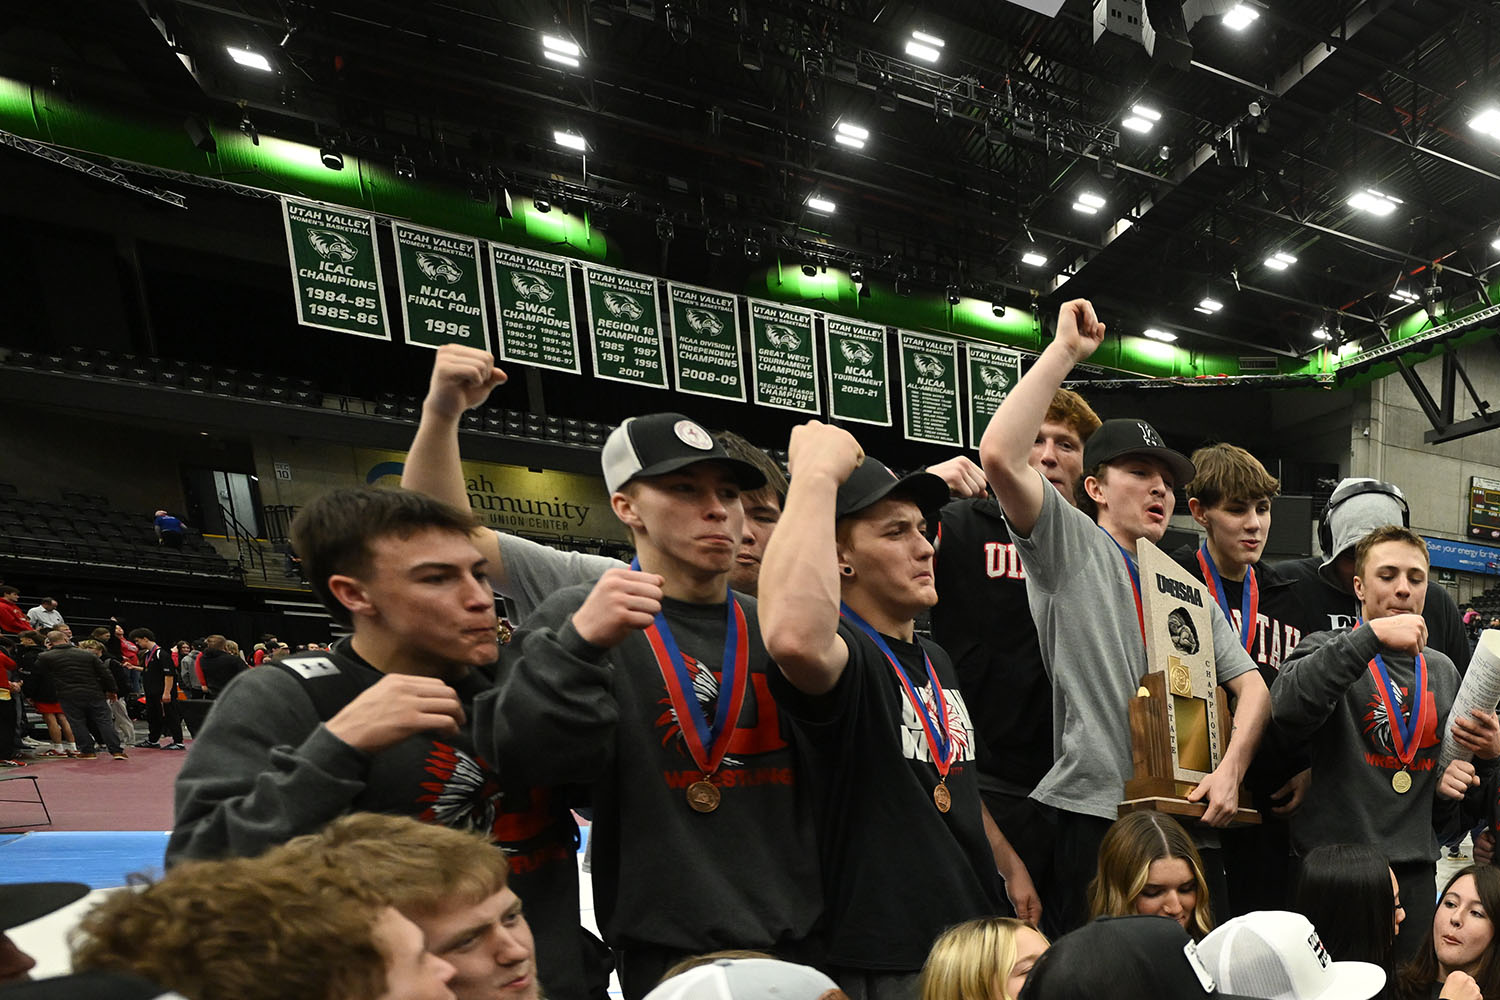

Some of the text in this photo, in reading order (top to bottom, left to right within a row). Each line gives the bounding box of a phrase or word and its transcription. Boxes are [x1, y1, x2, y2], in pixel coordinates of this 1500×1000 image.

[289, 206, 368, 229] UTAH VALLEY
[290, 214, 370, 236] WOMEN'S BASKETBALL
[399, 230, 473, 252] UTAH VALLEY
[400, 238, 474, 259] WOMEN'S BASKETBALL
[319, 261, 354, 276] ICAC
[496, 251, 564, 272] UTAH VALLEY
[496, 259, 565, 278] WOMEN'S BASKETBALL
[300, 268, 376, 291] CHAMPIONS
[590, 272, 652, 290] UTAH VALLEY
[306, 287, 376, 309] 1984-85
[420, 285, 466, 302] NJCAA
[618, 286, 652, 296] BASKETBALL
[673, 290, 732, 306] UTAH VALLEY
[408, 294, 480, 316] FINAL FOUR
[516, 301, 556, 316] SWAC
[700, 302, 733, 312] BASKETBALL
[309, 304, 378, 325] 1985-86
[503, 309, 570, 329] CHAMPIONS
[754, 306, 810, 323] UTAH VALLEY
[425, 319, 470, 338] 1996
[598, 319, 654, 335] REGION 18
[830, 322, 881, 337] UTAH VALLEY
[596, 328, 658, 345] CHAMPIONS
[680, 336, 697, 344] NCAA
[700, 339, 732, 350] DIVISION
[903, 337, 953, 351] UTAH VALLEY
[600, 341, 657, 357] 1985 1987
[679, 344, 736, 358] INDEPENDENT
[759, 348, 810, 363] GREAT WEST
[971, 350, 1017, 363] UTAH VALLEY
[602, 352, 658, 369] 1991 1996
[679, 351, 737, 368] CHAMPIONS
[759, 356, 811, 370] TOURNAMENT
[619, 367, 644, 377] 2001
[682, 368, 737, 385] 2008-09
[758, 363, 813, 379] CHAMPIONS
[845, 366, 873, 378] NCAA
[775, 376, 798, 386] 2010
[834, 373, 883, 387] TOURNAMENT
[917, 377, 945, 388] NJCAA
[760, 387, 814, 402] CHAMPIONS
[841, 385, 877, 397] 2020-21
[907, 383, 954, 395] ALL-AMERICANS
[985, 389, 1006, 398] NCAA
[769, 396, 806, 408] 2012-13
[277, 470, 289, 479] 10
[490, 514, 569, 531] UNION CENTER
[1442, 545, 1457, 553] your
[1457, 548, 1478, 558] energy
[1479, 549, 1488, 558] for
[1488, 551, 1498, 560] the
[1167, 703, 1177, 754] STATE
